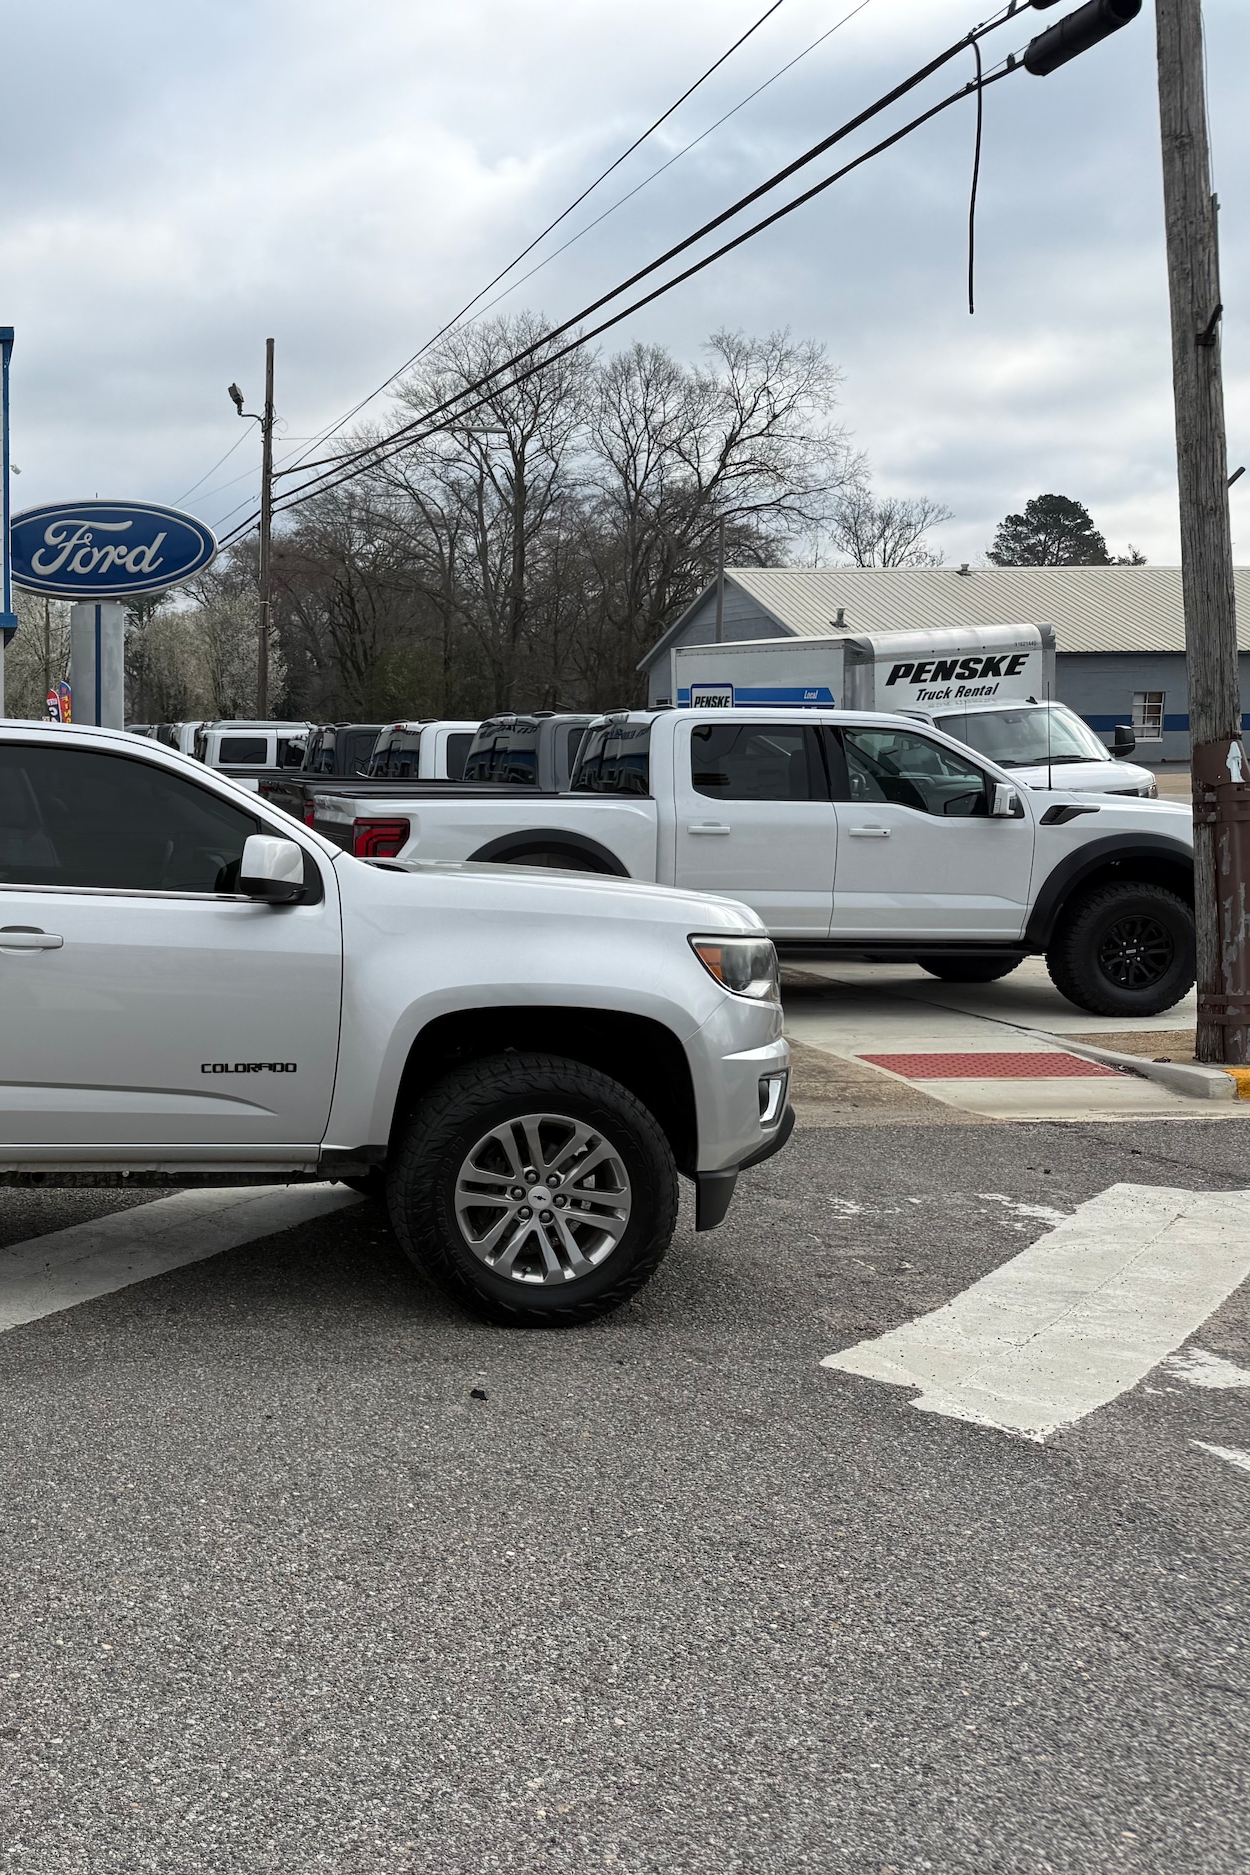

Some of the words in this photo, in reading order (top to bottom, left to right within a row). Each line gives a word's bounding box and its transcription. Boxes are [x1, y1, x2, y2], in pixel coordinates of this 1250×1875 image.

[31, 520, 168, 576] Ford
[885, 653, 1030, 686] PENSKE
[916, 686, 952, 701] Truck
[954, 682, 1000, 698] Rental
[694, 695, 731, 709] PENSKE
[200, 1062, 298, 1074] COLORADO
